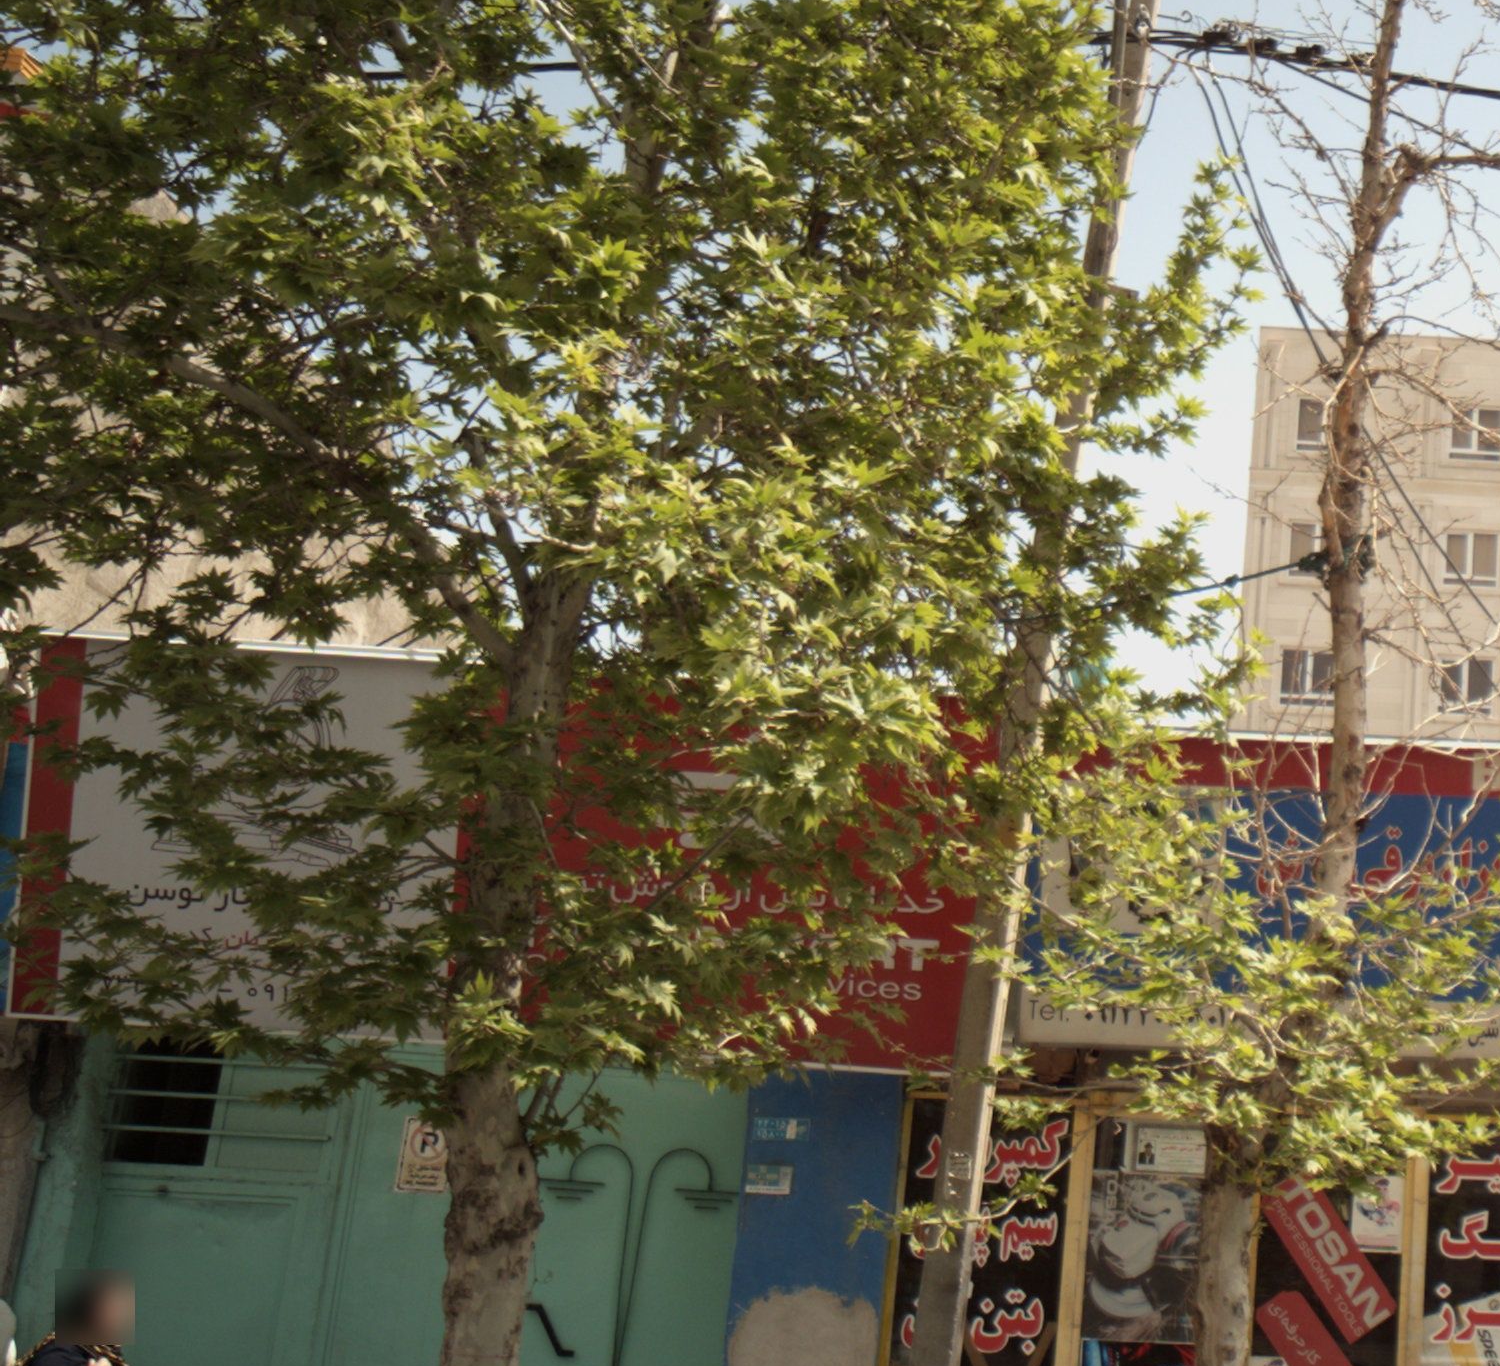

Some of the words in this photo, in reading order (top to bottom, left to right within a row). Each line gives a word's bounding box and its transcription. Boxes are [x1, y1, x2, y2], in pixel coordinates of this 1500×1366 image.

[1000, 1212, 1058, 1262] سیم
[1271, 1199, 1335, 1295] PROFESSIONAL
[1333, 1293, 1366, 1337] TOOLS
[1280, 1175, 1391, 1329] TOSAN
[971, 1289, 1044, 1355] بتن
